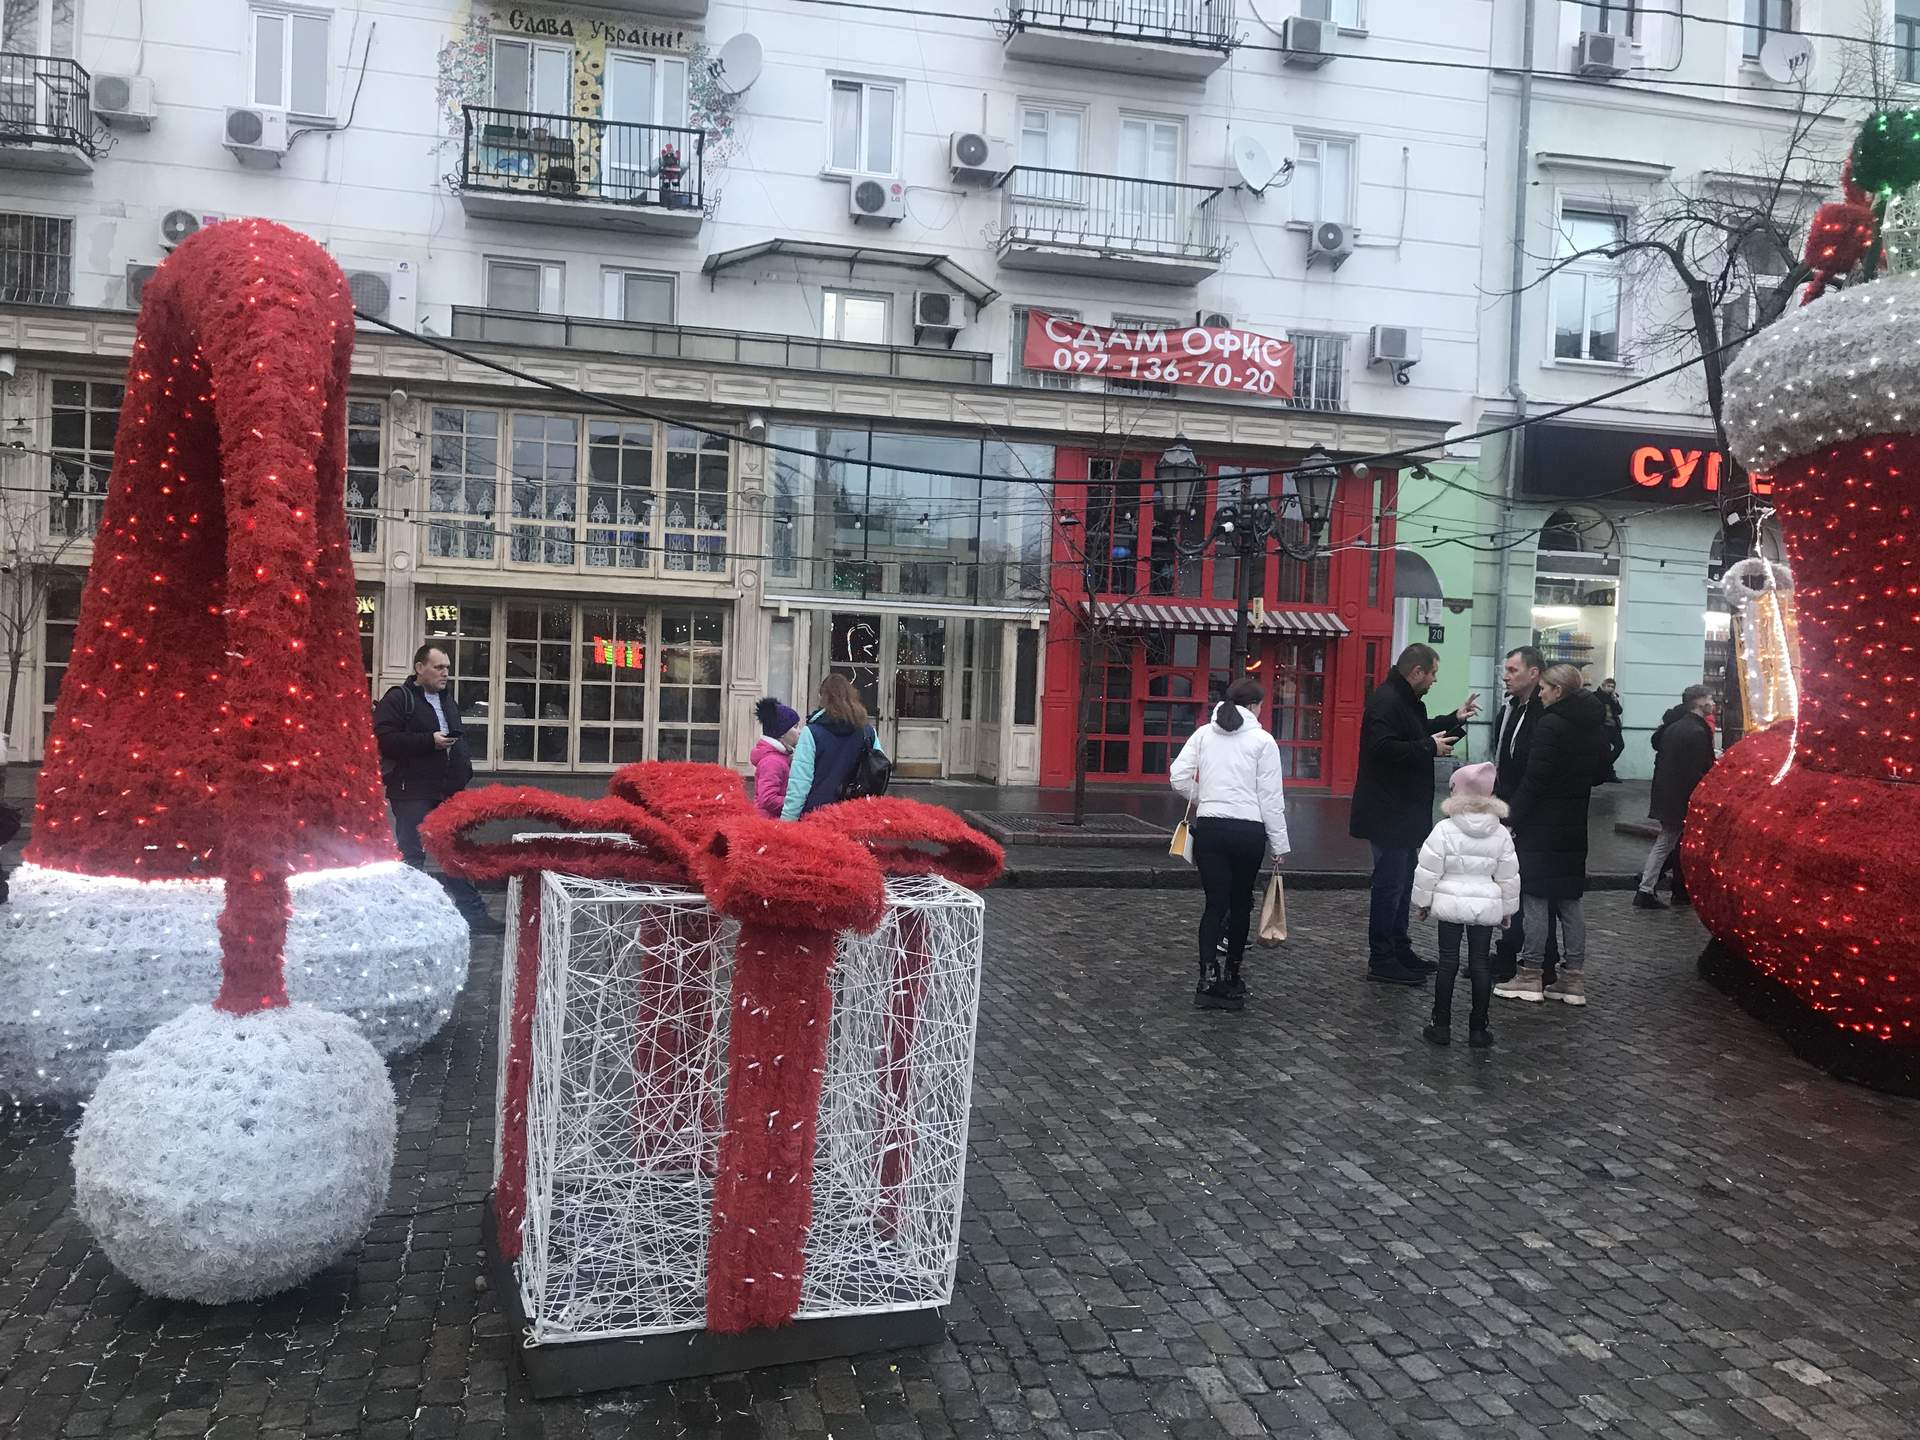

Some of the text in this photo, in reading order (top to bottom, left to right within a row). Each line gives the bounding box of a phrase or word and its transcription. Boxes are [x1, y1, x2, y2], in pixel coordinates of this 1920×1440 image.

[509, 9, 574, 37] Слава
[1045, 317, 1283, 367] СДАМ ОФИС
